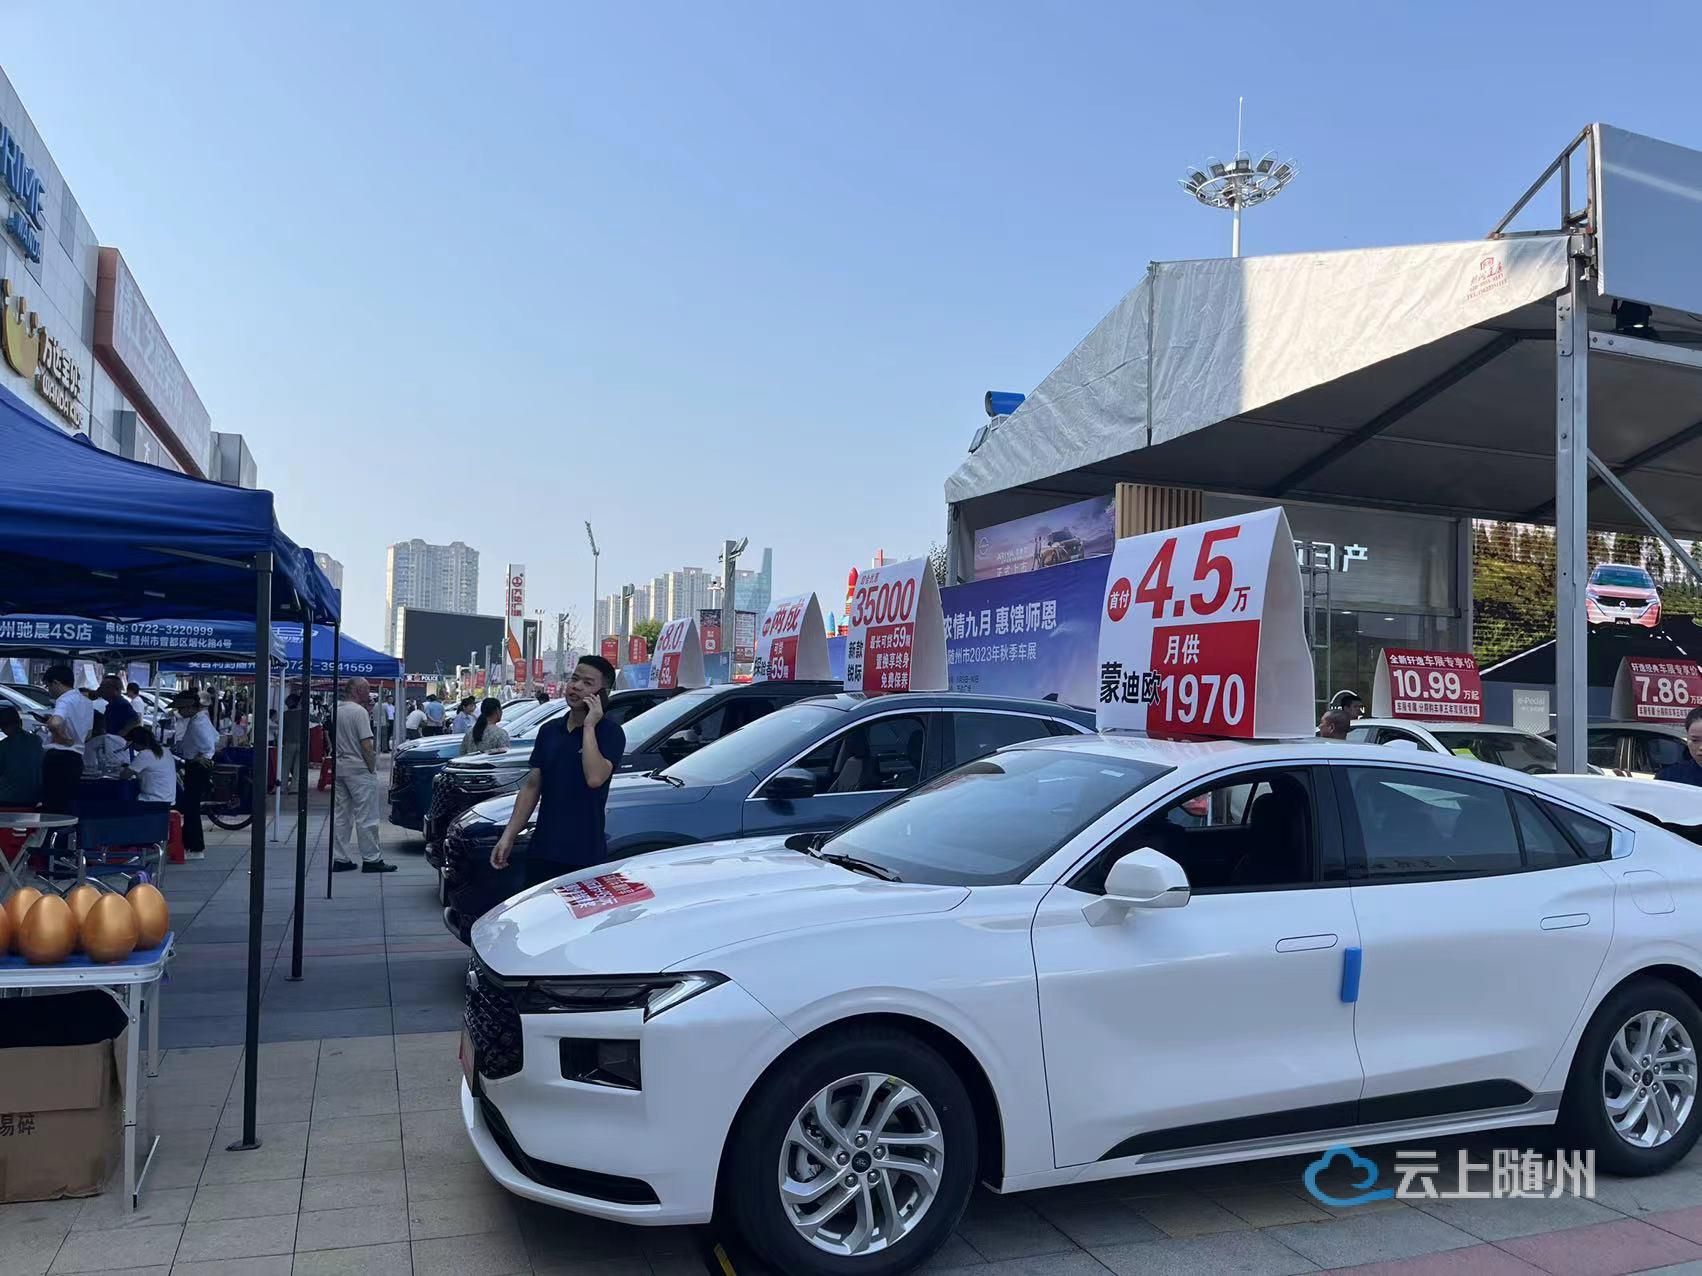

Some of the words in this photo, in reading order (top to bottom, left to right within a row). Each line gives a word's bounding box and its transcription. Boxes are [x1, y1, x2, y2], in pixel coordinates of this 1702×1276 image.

[1135, 525, 1241, 619] 4.5
[1231, 586, 1251, 613] 万
[851, 577, 916, 627] 35000
[1109, 590, 1130, 610] 首付
[131, 623, 214, 636] 0722-3220999
[995, 599, 1058, 635] 惠馈师恩
[947, 641, 1038, 665] 随州市2023年秋季车展
[1164, 634, 1200, 665] 月供
[880, 671, 909, 689] 免费保养
[1100, 661, 1161, 706] 蒙迪欧
[1393, 669, 1461, 700] 10.99
[1463, 689, 1480, 701] 万起
[1634, 675, 1690, 704] 7.86
[1160, 673, 1245, 726] 1970
[0, 1112, 35, 1136] 易碎
